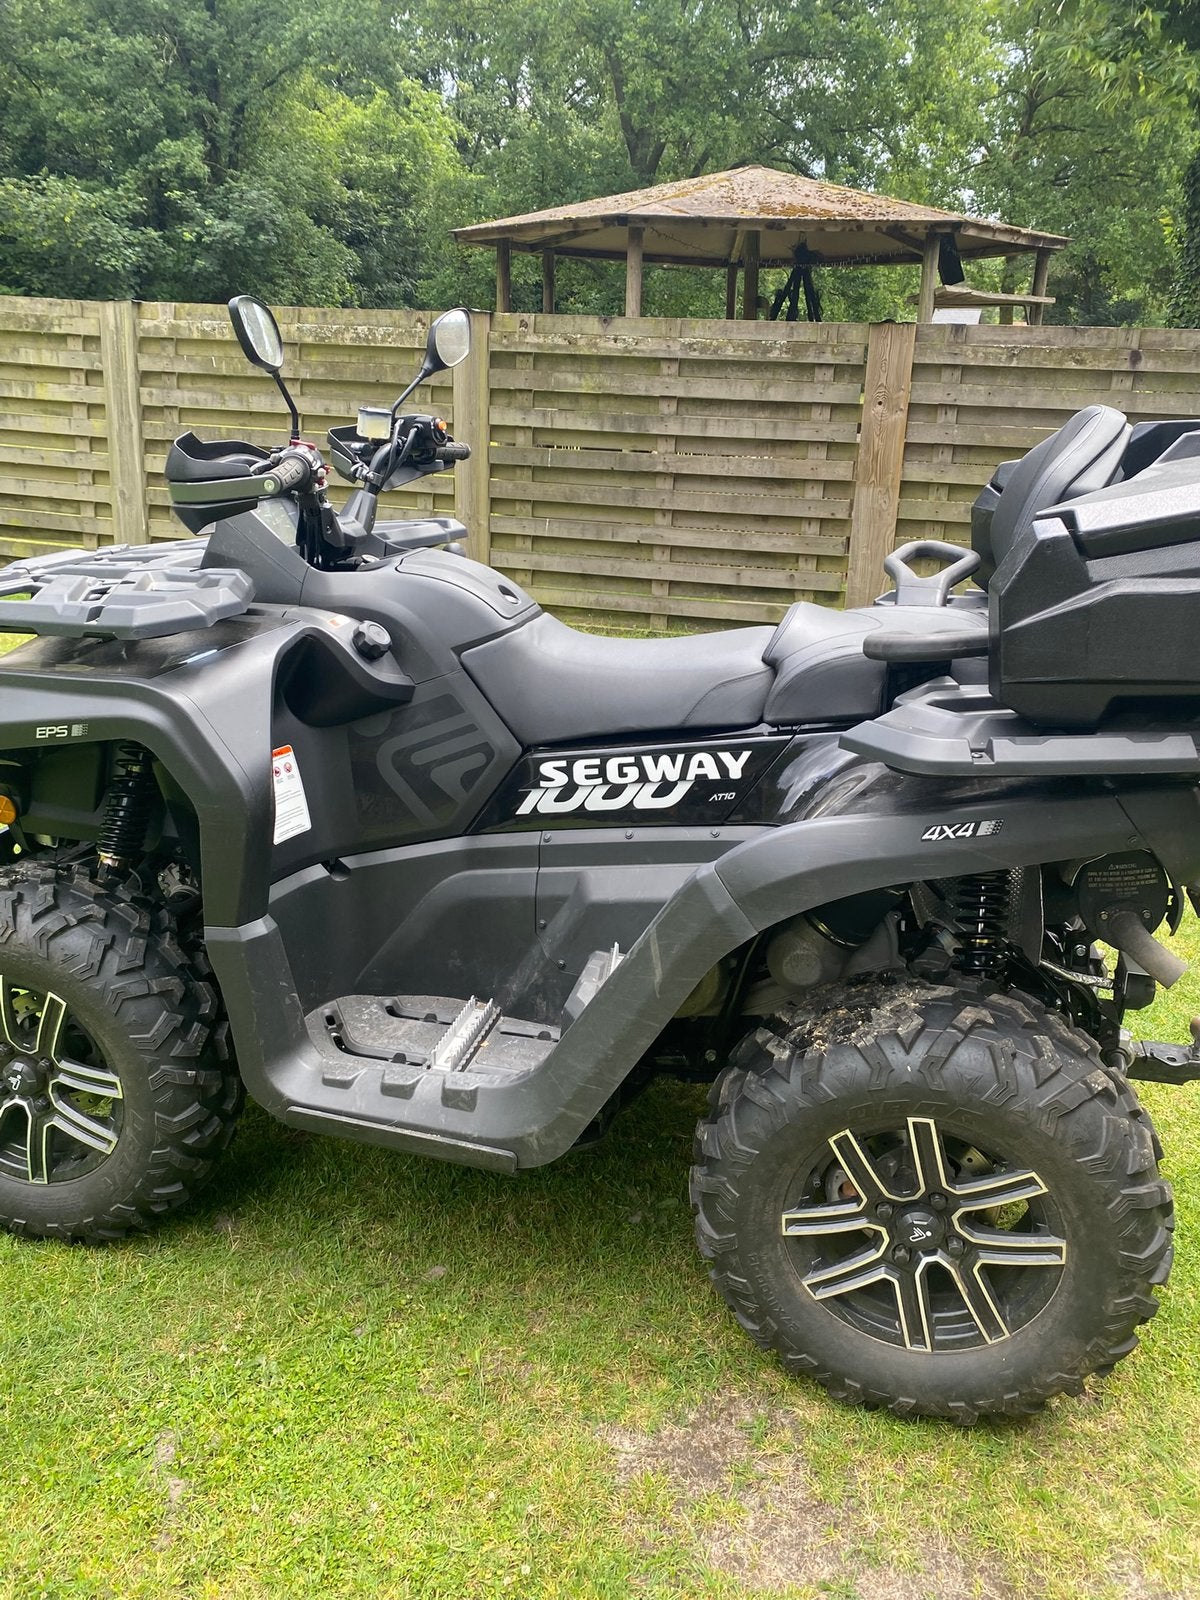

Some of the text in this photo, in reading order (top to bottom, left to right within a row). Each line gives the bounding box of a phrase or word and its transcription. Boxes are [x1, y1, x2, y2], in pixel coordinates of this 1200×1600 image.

[36, 725, 68, 738] EPS
[539, 750, 753, 788] SEGWAY
[709, 791, 736, 802] AT10
